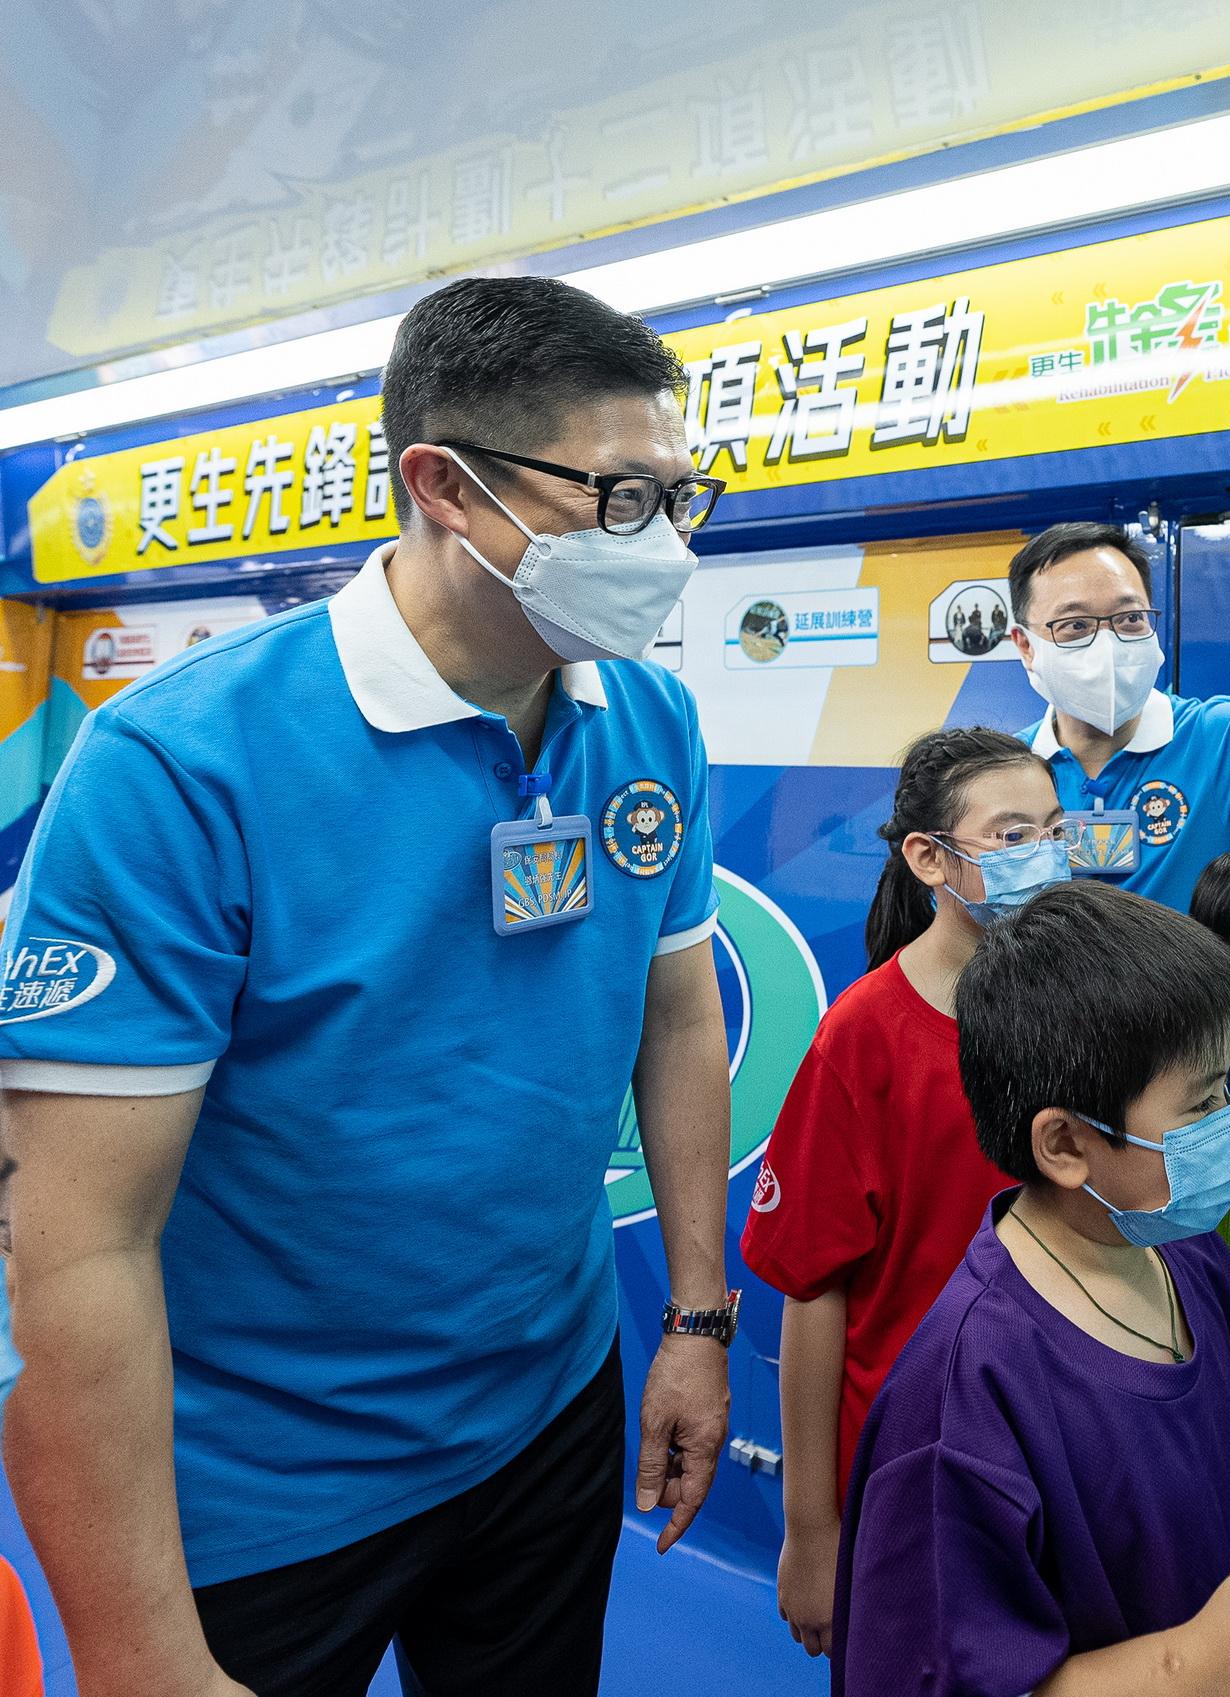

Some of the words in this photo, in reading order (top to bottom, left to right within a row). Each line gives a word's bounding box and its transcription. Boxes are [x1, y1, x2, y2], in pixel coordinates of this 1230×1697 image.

[794, 608, 874, 631] 延展訓練營
[631, 843, 664, 855] CAPTAIN
[641, 852, 658, 863] GOR
